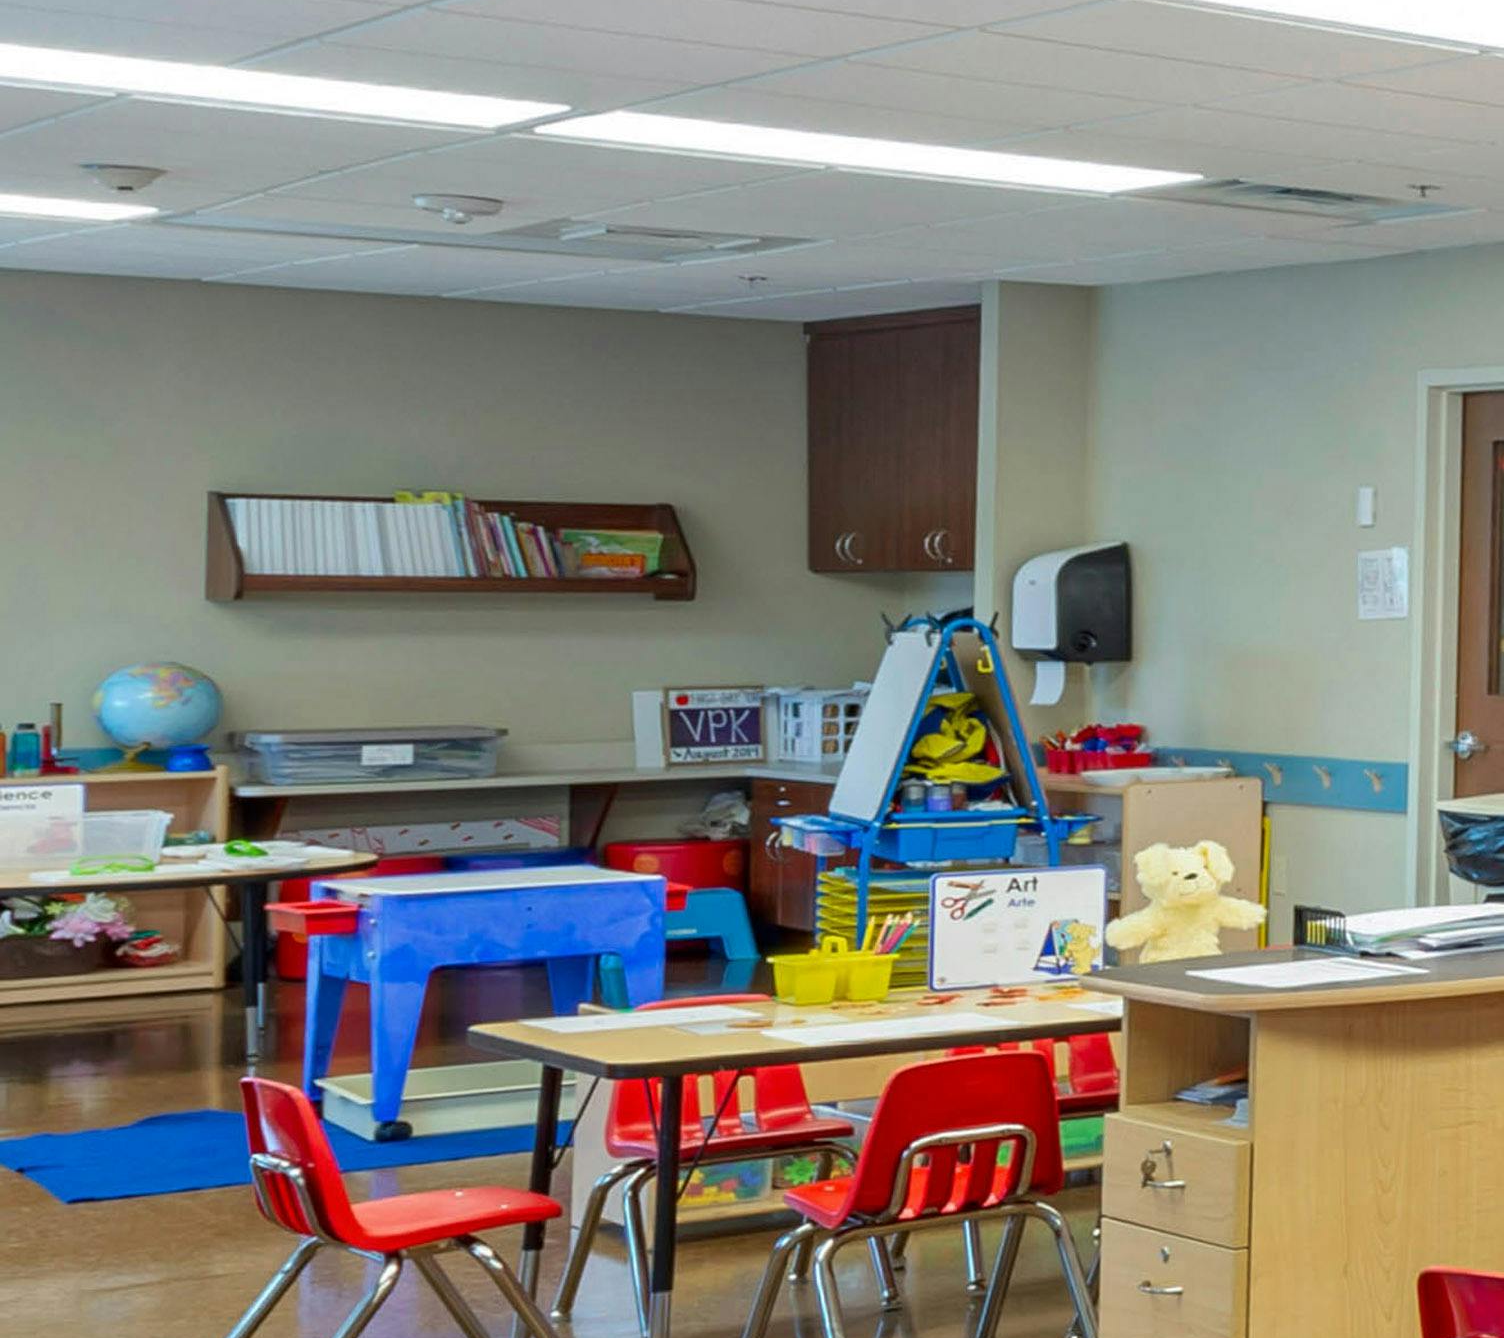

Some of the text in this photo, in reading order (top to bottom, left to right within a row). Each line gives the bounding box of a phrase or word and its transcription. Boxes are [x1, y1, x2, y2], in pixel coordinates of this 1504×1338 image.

[679, 709, 750, 742] VPK
[1007, 877, 1038, 893] Art
[1007, 898, 1036, 908] Arte
